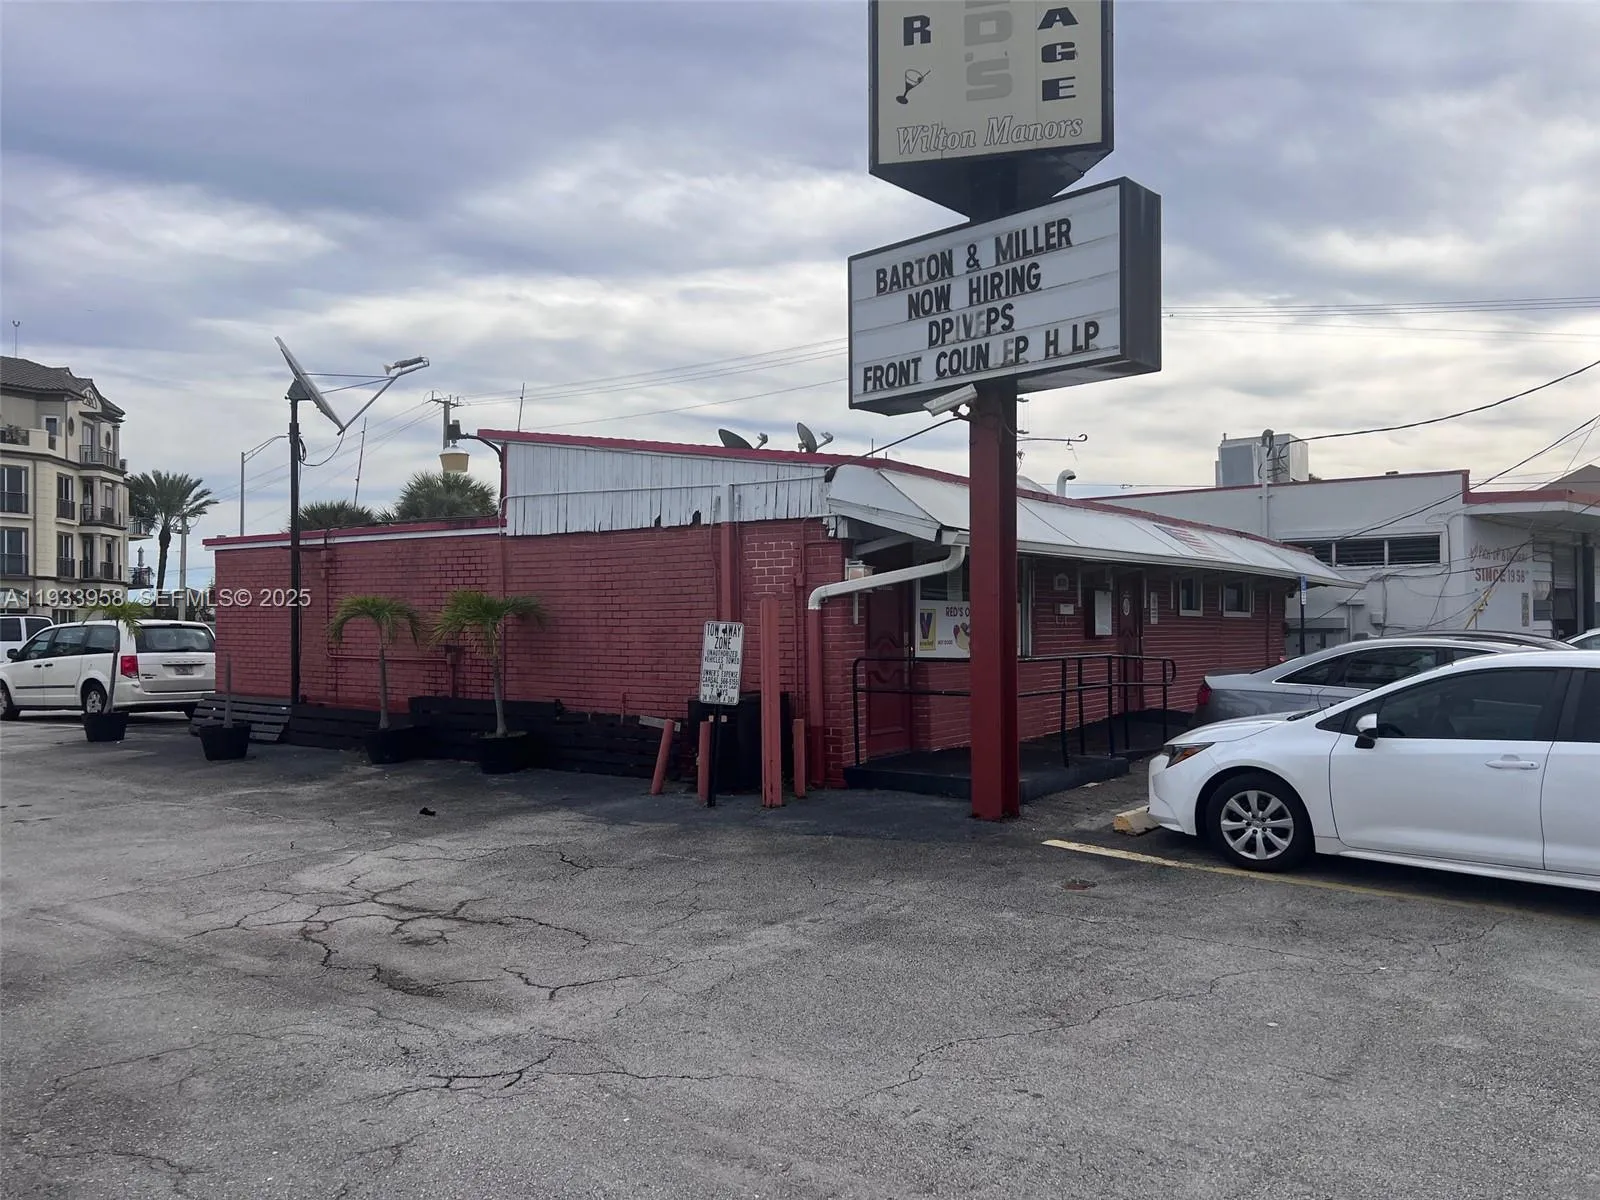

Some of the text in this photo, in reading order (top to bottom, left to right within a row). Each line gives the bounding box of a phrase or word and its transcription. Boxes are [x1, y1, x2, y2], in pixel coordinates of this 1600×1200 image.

[896, 115, 1084, 155] Wilton Manors
[875, 217, 1073, 297] BARTON & MILLER
[907, 262, 1042, 320] NOW HIRING
[863, 357, 922, 394] FRONT
[945, 606, 965, 618] RED'S
[707, 623, 719, 637] TOW
[714, 636, 732, 650] ZONE
[721, 671, 739, 679] EXPENSE
